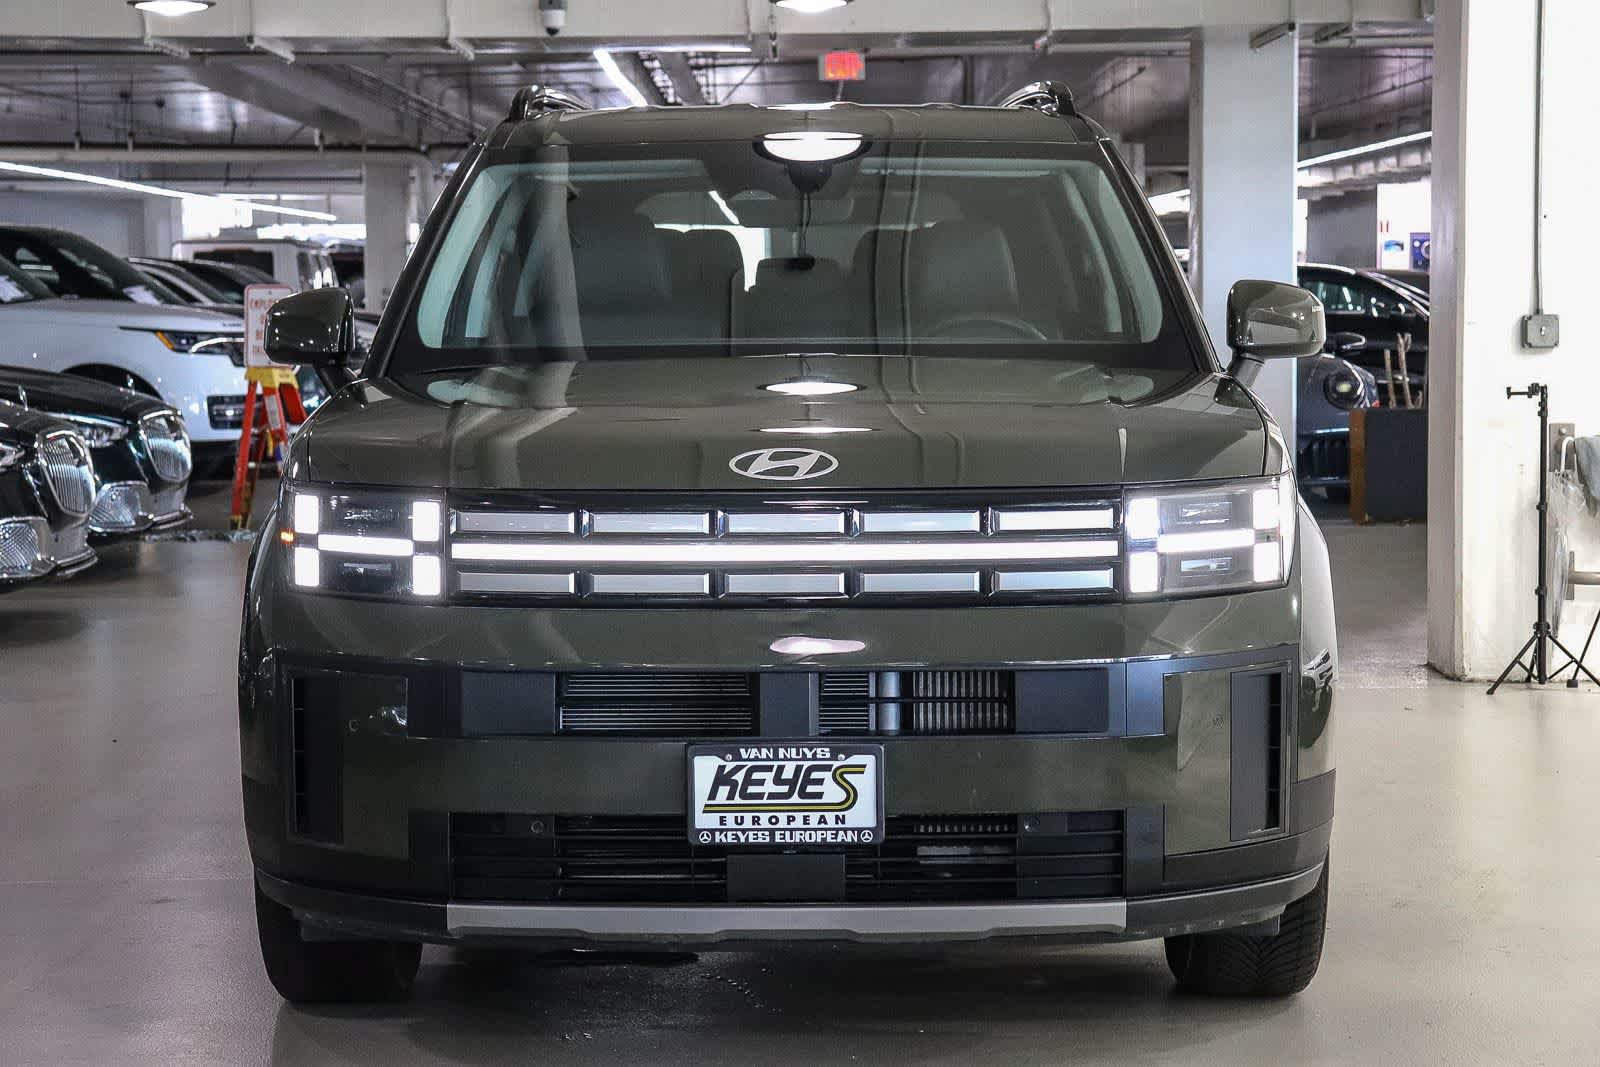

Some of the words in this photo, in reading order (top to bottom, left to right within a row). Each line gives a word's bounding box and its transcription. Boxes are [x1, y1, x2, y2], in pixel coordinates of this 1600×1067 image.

[739, 748, 773, 759] VAN
[778, 748, 830, 759] NUYS
[707, 764, 867, 812] KEYES
[719, 815, 847, 826] EUROPEAN
[715, 831, 769, 843] KEYES
[775, 830, 858, 843] EUROPEAN
